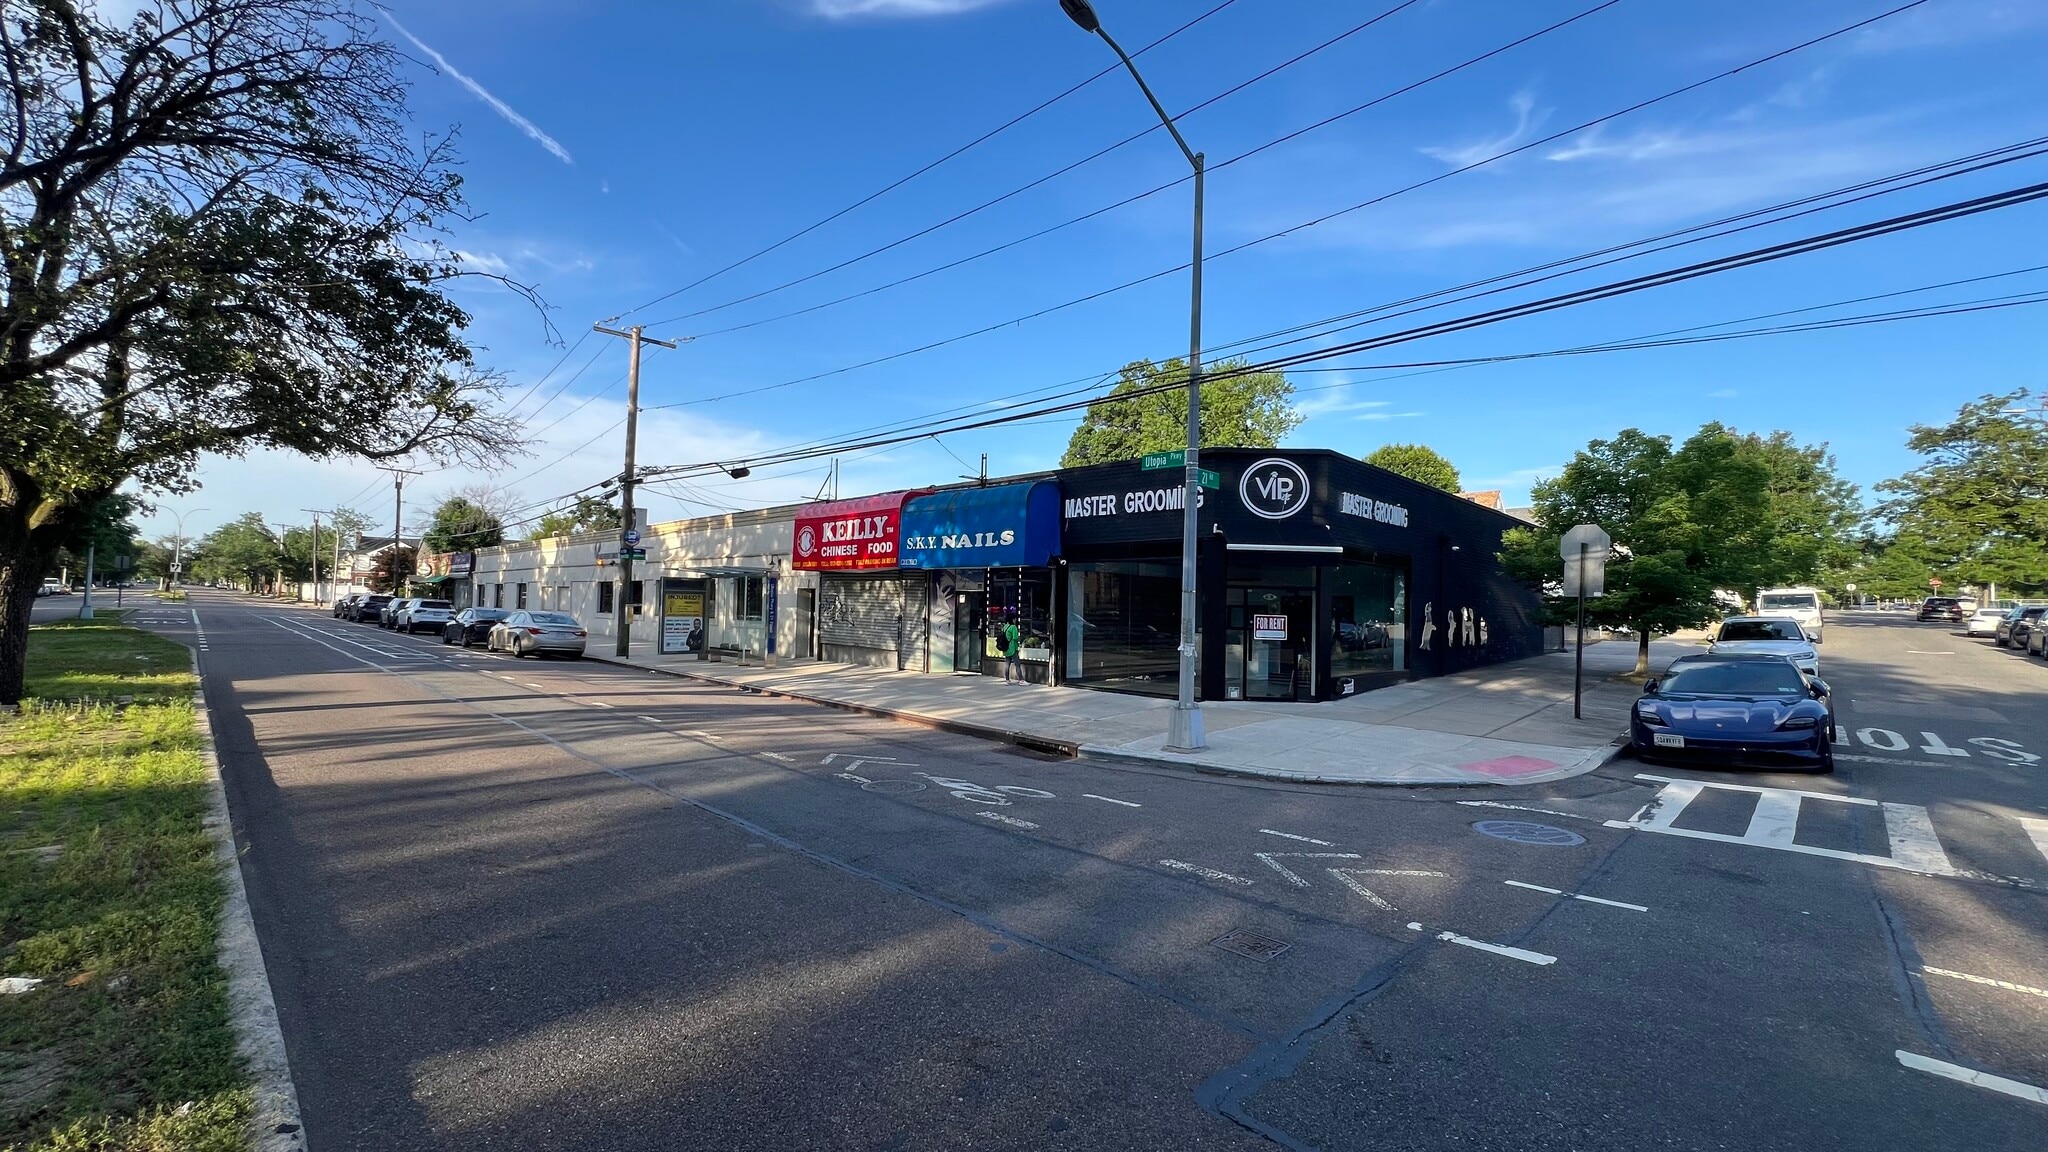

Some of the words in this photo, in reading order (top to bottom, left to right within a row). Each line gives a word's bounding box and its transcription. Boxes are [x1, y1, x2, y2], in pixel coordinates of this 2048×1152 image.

[1145, 455, 1167, 468] Utopia
[1170, 452, 1183, 461] Pkwy
[1202, 472, 1208, 484] 21
[1064, 495, 1117, 518] MASTER
[1340, 492, 1373, 520] MASTER
[1374, 500, 1409, 528] GROOMING
[822, 515, 888, 543] KEILLY
[821, 545, 858, 557] CHINESE
[868, 541, 893, 554] FOOD
[906, 536, 937, 550] S.K.Y.
[941, 530, 1015, 549] NAILS
[1256, 617, 1268, 629] FOR
[1269, 617, 1285, 630] RENT
[1834, 725, 2042, 763] STO
